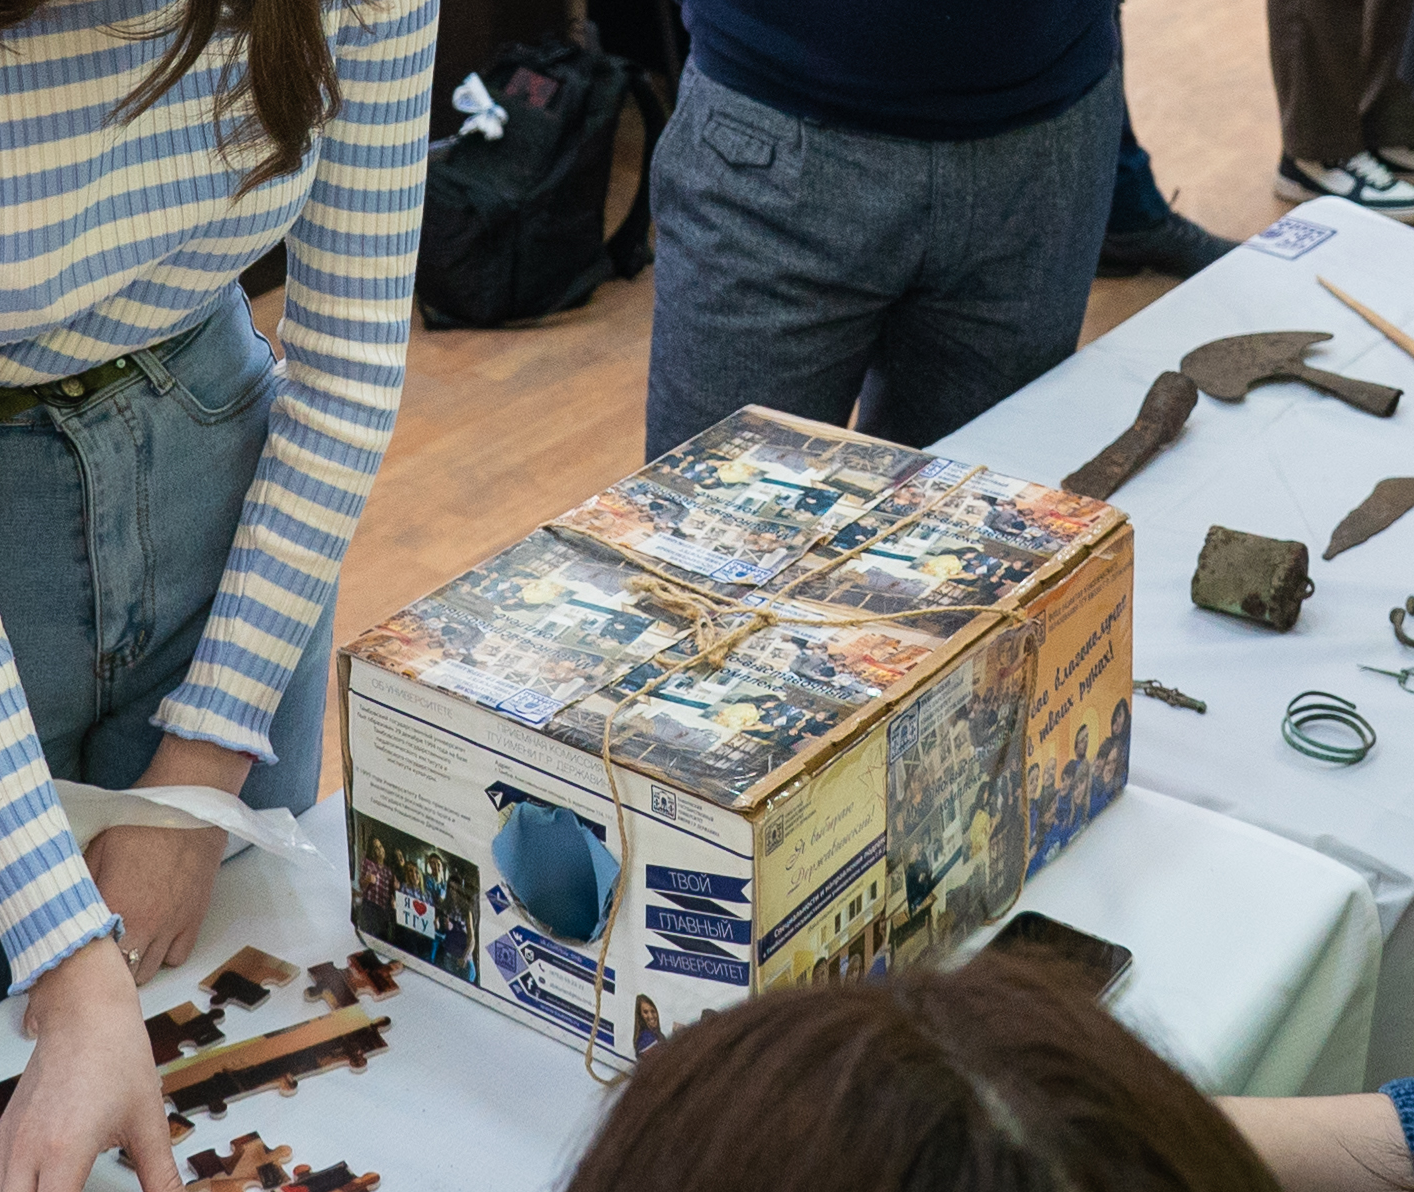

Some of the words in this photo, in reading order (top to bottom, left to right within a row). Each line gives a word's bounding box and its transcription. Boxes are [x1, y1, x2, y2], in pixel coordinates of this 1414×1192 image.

[720, 667, 787, 693] омплекс
[556, 758, 611, 792] ДЕРЖАВИН
[668, 870, 712, 894] ТВОЙ
[404, 897, 411, 909] Я
[403, 910, 429, 932] ТГУ
[659, 912, 734, 939] ГЛАВНЫЙ
[656, 951, 745, 980] УНИВЕРСИТЕТ
